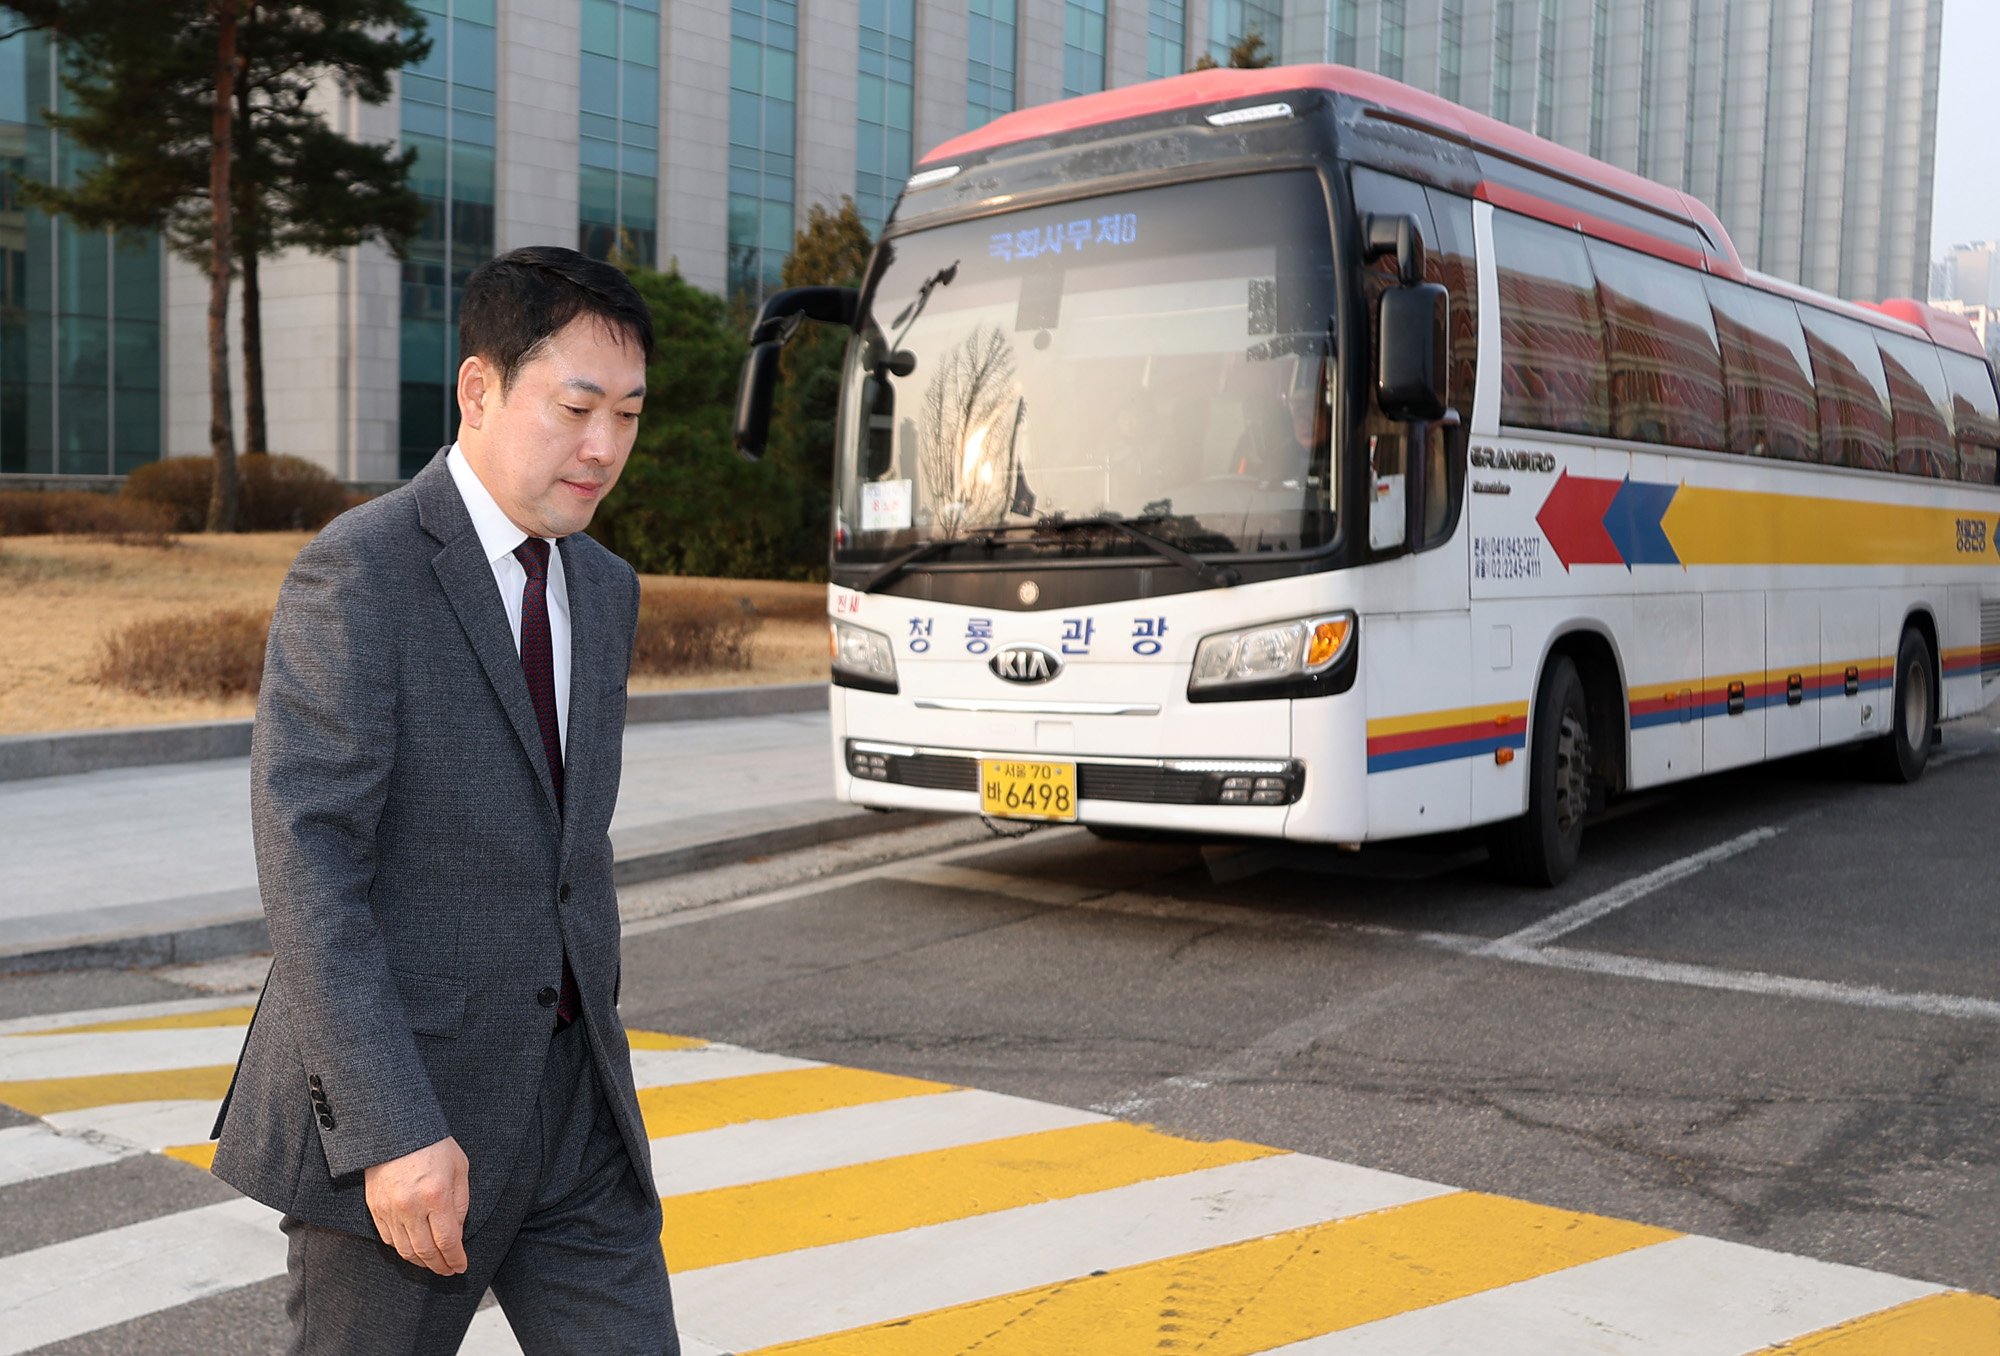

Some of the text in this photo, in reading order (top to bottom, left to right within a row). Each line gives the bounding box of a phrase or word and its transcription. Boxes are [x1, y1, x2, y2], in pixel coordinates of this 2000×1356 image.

[1470, 446, 1556, 472] GRANBIRD
[1956, 517, 1986, 552] 청룡관광
[996, 651, 1050, 678] KIA
[1005, 764, 1051, 779] 서울 70
[1006, 782, 1069, 811] 6498
